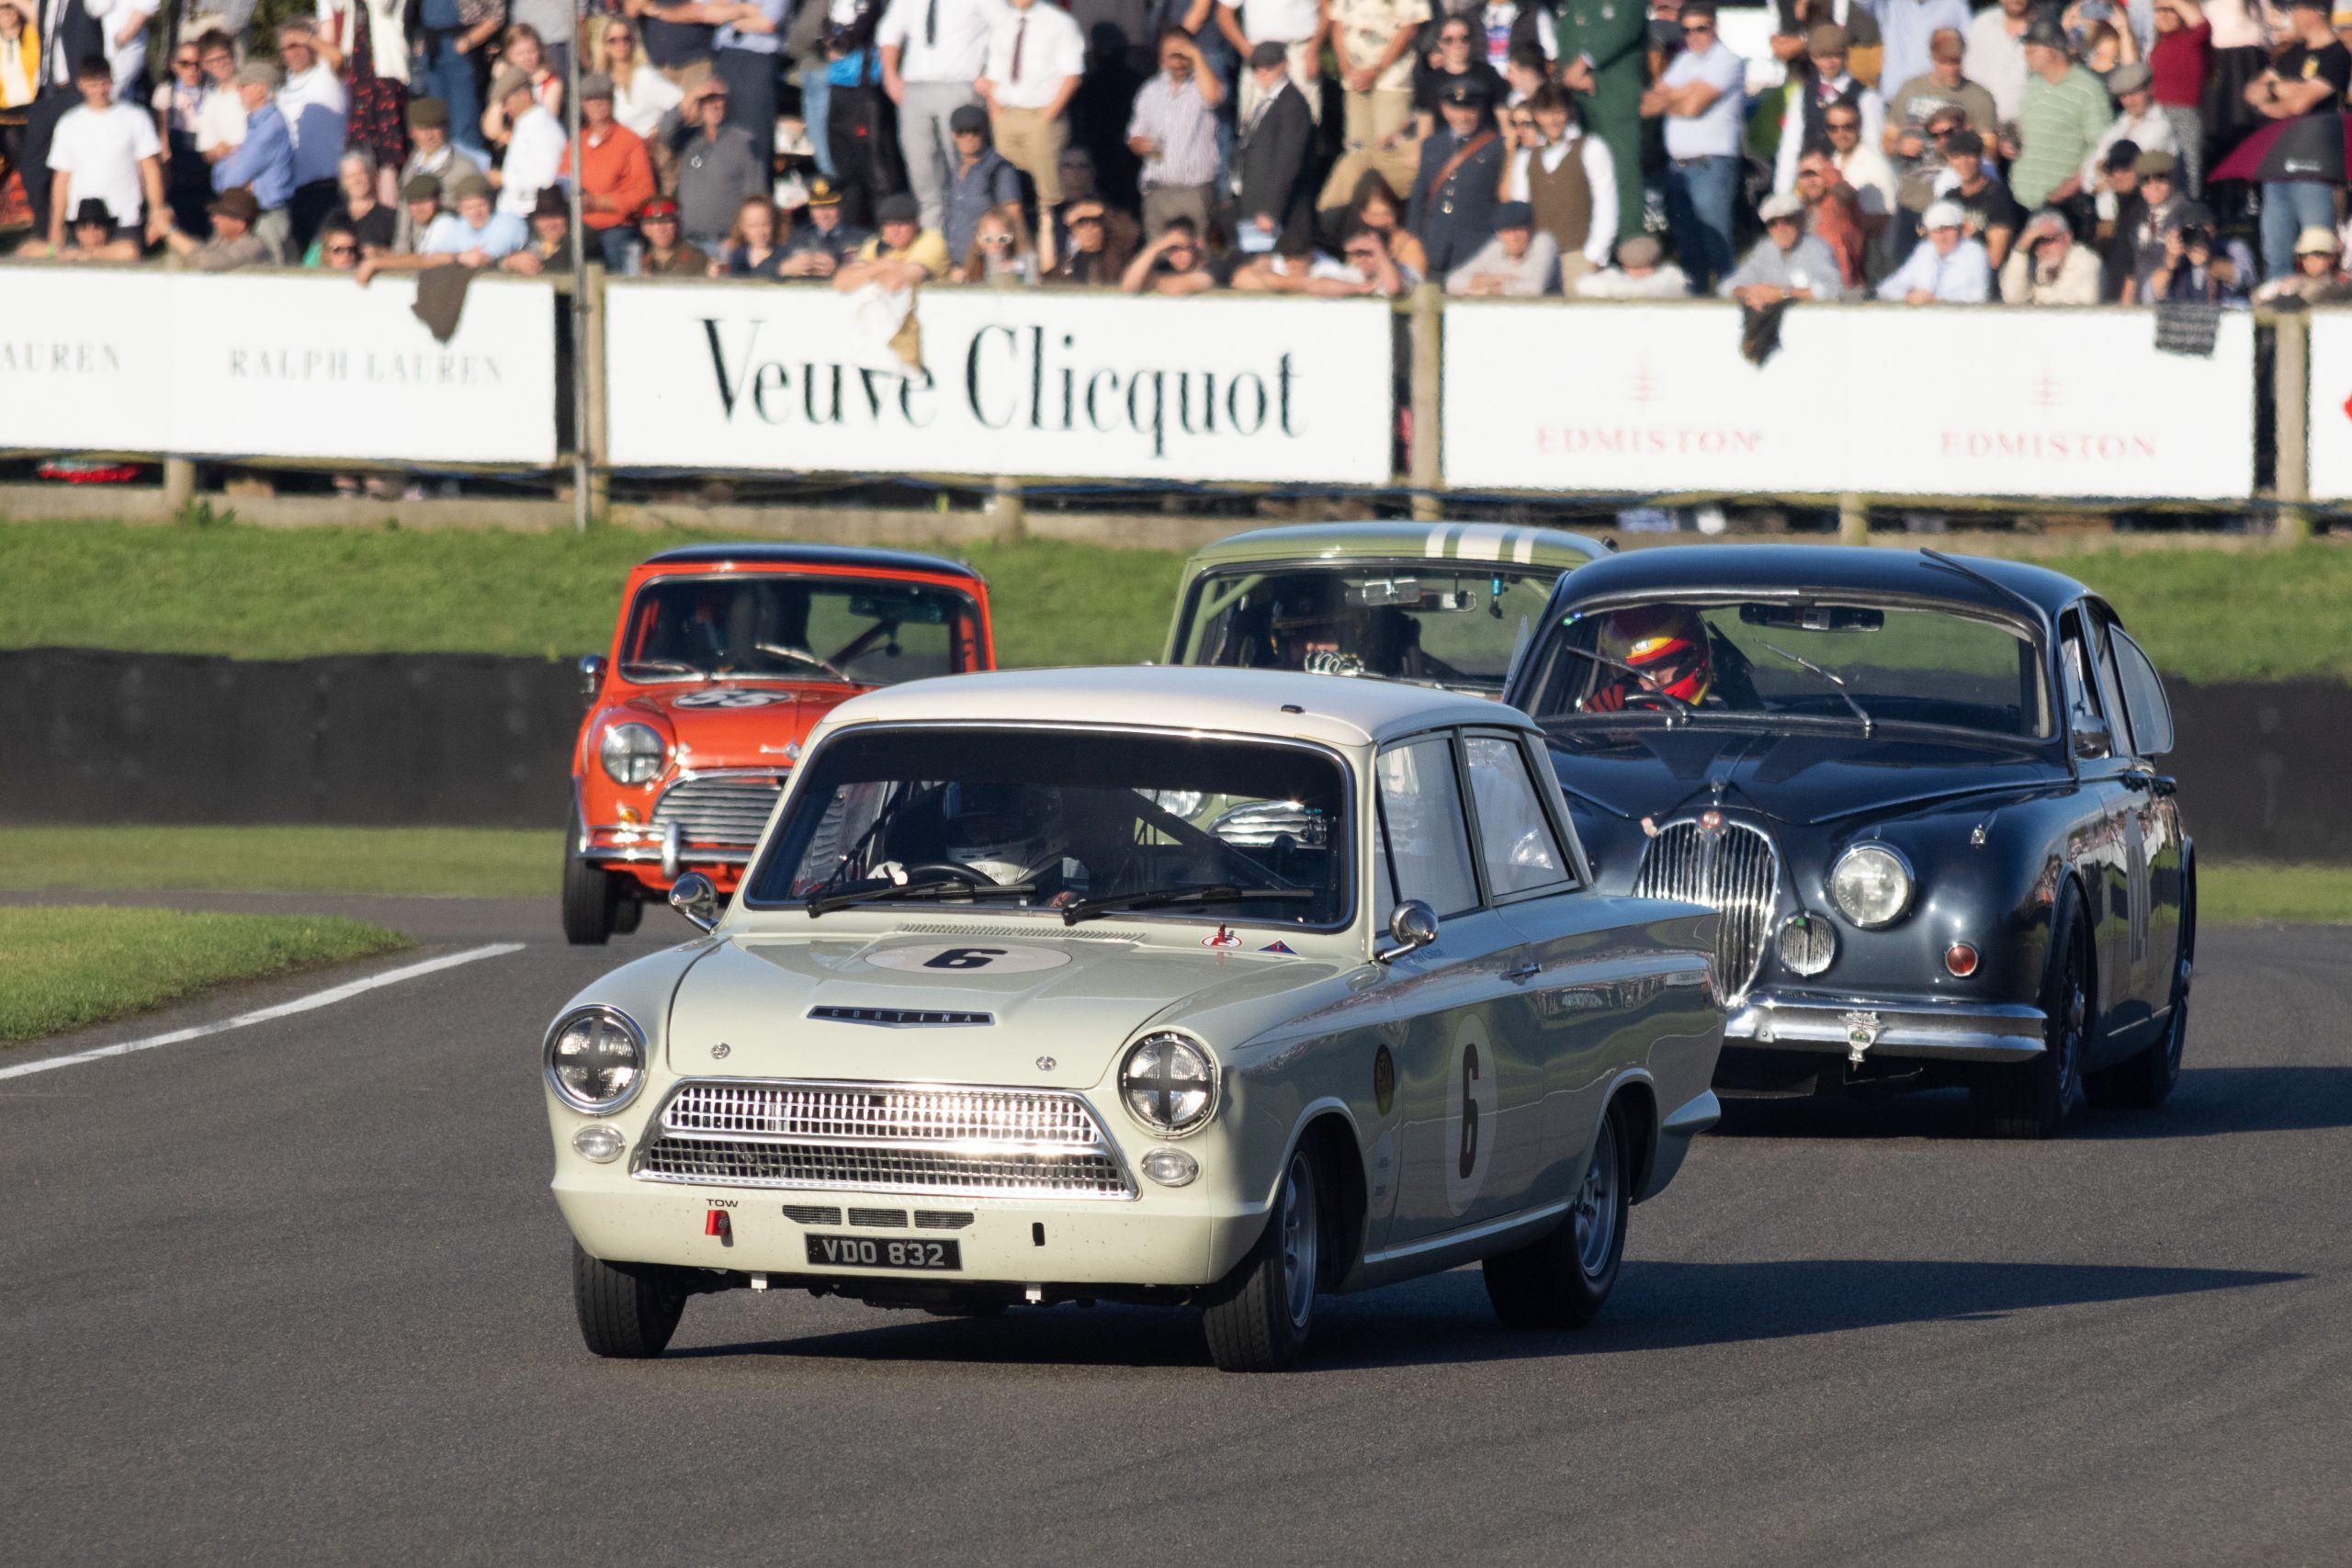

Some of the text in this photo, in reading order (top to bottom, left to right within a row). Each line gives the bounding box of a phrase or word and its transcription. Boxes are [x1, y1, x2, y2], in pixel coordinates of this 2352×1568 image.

[230, 349, 502, 385] RALPH LAUREN
[695, 318, 1308, 459] Veuve Clicquot
[1537, 426, 1758, 454] EDMISTON
[1939, 432, 2155, 460] EDMISTON
[922, 949, 1008, 969] 6
[831, 1010, 971, 1022] CORTINA
[1459, 1043, 1479, 1178] 6
[707, 1199, 739, 1208] TOW
[822, 1240, 945, 1267] VDO 832
